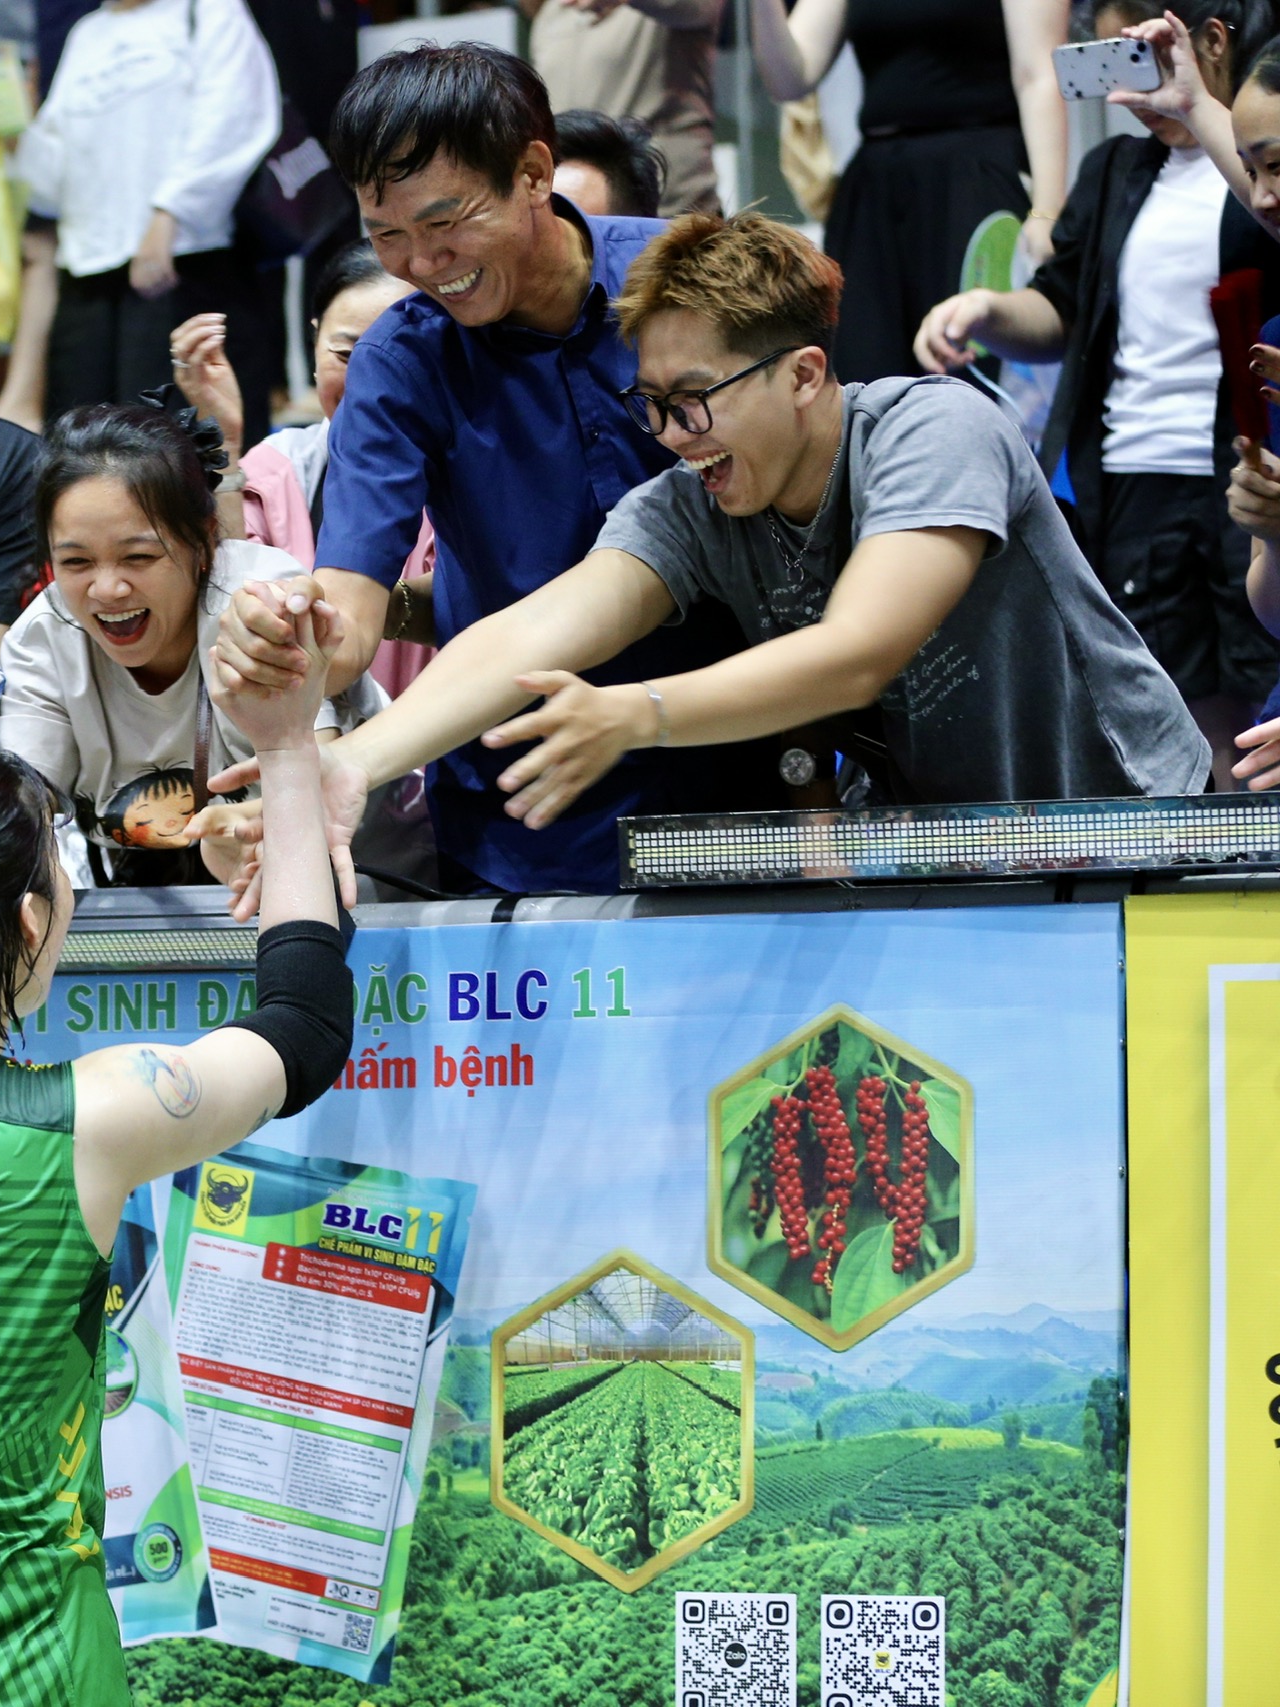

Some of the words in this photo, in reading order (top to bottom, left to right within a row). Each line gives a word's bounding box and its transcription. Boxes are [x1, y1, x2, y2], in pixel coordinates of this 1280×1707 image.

[65, 983, 177, 1034] SINH
[353, 963, 429, 1037] ẶC
[447, 968, 550, 1022] BLC
[572, 965, 632, 1019] 11
[433, 1043, 534, 1097] bệnh
[322, 1202, 404, 1241] BLC
[404, 1206, 445, 1255] 11
